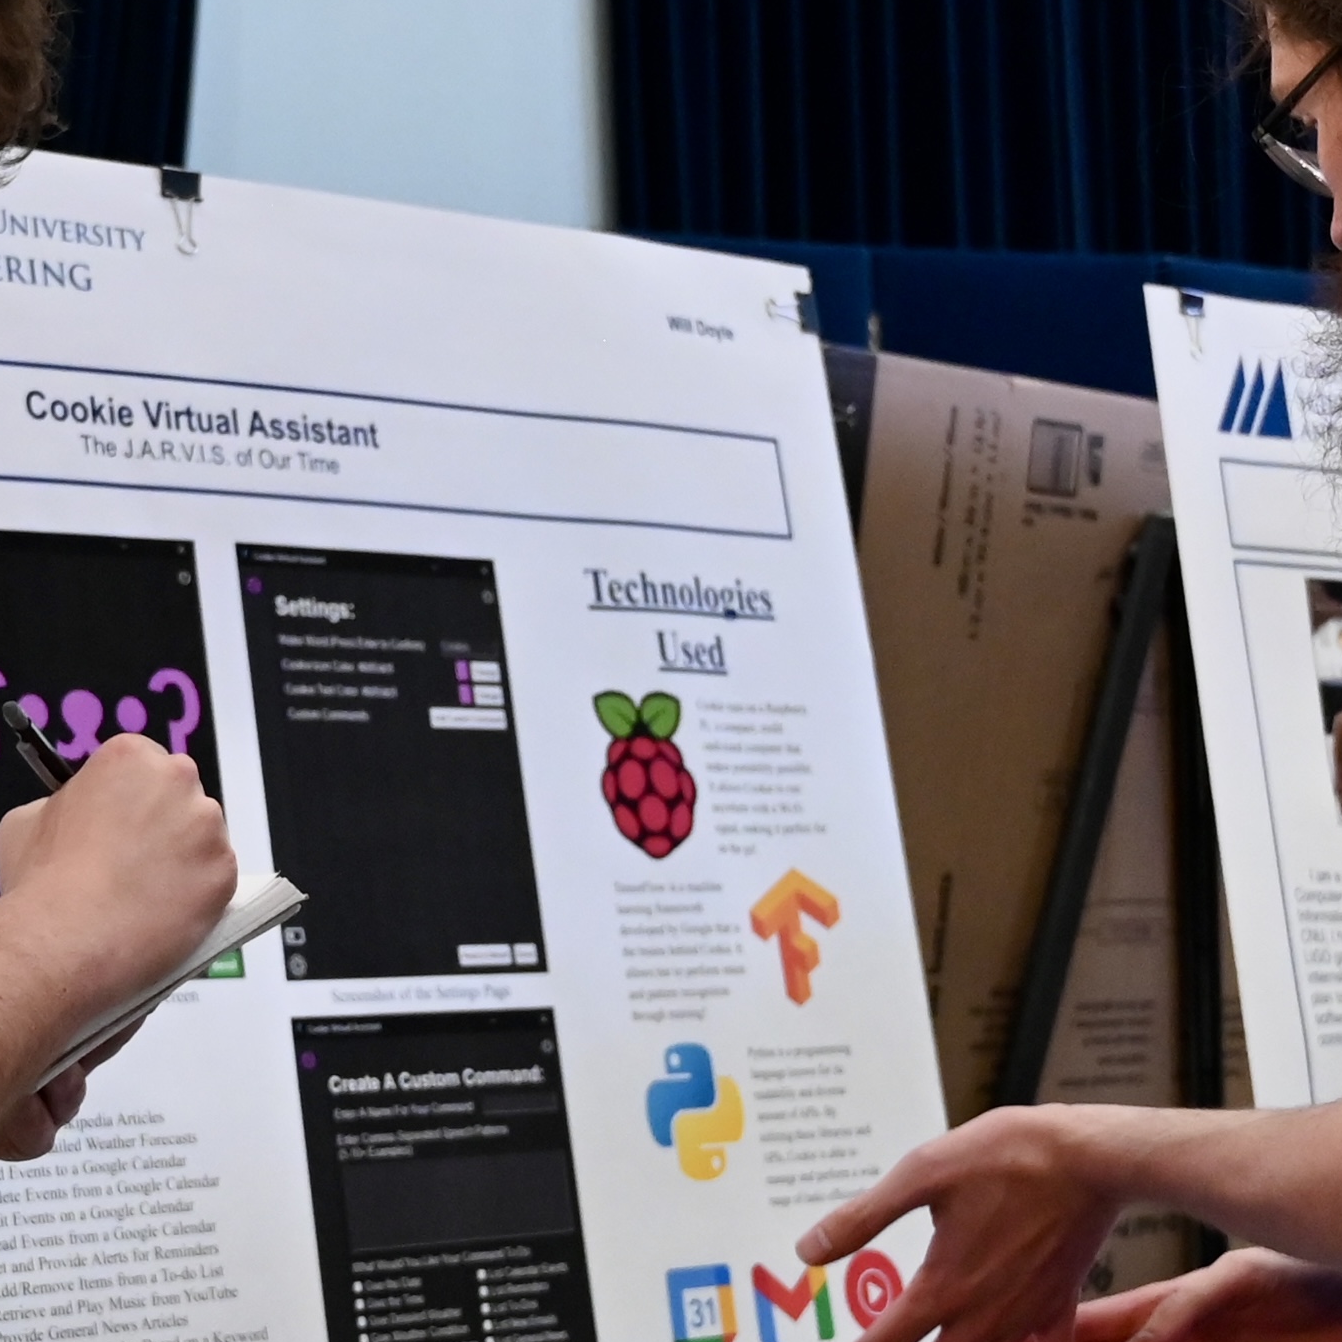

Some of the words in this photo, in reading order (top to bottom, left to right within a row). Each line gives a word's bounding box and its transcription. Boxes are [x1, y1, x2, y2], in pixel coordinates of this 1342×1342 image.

[666, 315, 692, 334] Will
[697, 320, 734, 342] Doyle
[25, 390, 134, 428] Cookie
[143, 400, 240, 436] Virtual
[249, 410, 379, 449] Assistant
[81, 435, 117, 458] The
[237, 447, 255, 467] of
[259, 449, 290, 471] Our
[298, 452, 340, 475] Time
[583, 568, 774, 619] Technologies
[274, 594, 356, 624] Settings:
[656, 630, 727, 669] Used
[328, 1074, 381, 1094] Create
[383, 1072, 397, 1090] A
[398, 1070, 461, 1091] Custom
[65, 1117, 114, 1132] kipedia
[118, 1112, 164, 1127] Articles
[86, 1134, 135, 1151] Weather
[140, 1133, 197, 1147] Forecasts
[9, 1165, 51, 1179] Events
[56, 1165, 67, 1176] to
[72, 1165, 79, 1175] a
[83, 1158, 127, 1175] Google
[132, 1154, 186, 1170] Calendar
[25, 1185, 68, 1202] Events
[73, 1182, 103, 1197] from
[106, 1186, 113, 1195] a
[117, 1179, 161, 1196] Google
[166, 1174, 220, 1190] Calendar
[13, 1210, 56, 1226] Events
[60, 1212, 75, 1223] on
[80, 1211, 87, 1220] a
[90, 1204, 134, 1220] Google
[139, 1198, 194, 1215] Calendar
[22, 1233, 64, 1250] Events
[69, 1229, 99, 1245] from
[103, 1233, 110, 1242] a
[114, 1225, 157, 1243] Google
[162, 1220, 216, 1237] Calendar
[11, 1258, 34, 1273] and
[38, 1254, 88, 1271] Provide
[92, 1250, 129, 1265] Alerts
[133, 1248, 150, 1262] for
[155, 1242, 219, 1261] Reminders
[79, 1277, 113, 1291] Items
[118, 1273, 147, 1287] from
[150, 1274, 158, 1284] a
[162, 1267, 196, 1283] To-do
[201, 1264, 224, 1279] List
[50, 1302, 73, 1317] and
[77, 1299, 105, 1315] Play
[109, 1296, 147, 1310] Music
[152, 1292, 181, 1306] from
[184, 1286, 238, 1303] YouTube
[688, 1297, 717, 1329] 31
[48, 1325, 98, 1342] General
[102, 1321, 137, 1335] News
[142, 1314, 188, 1330] Articles
